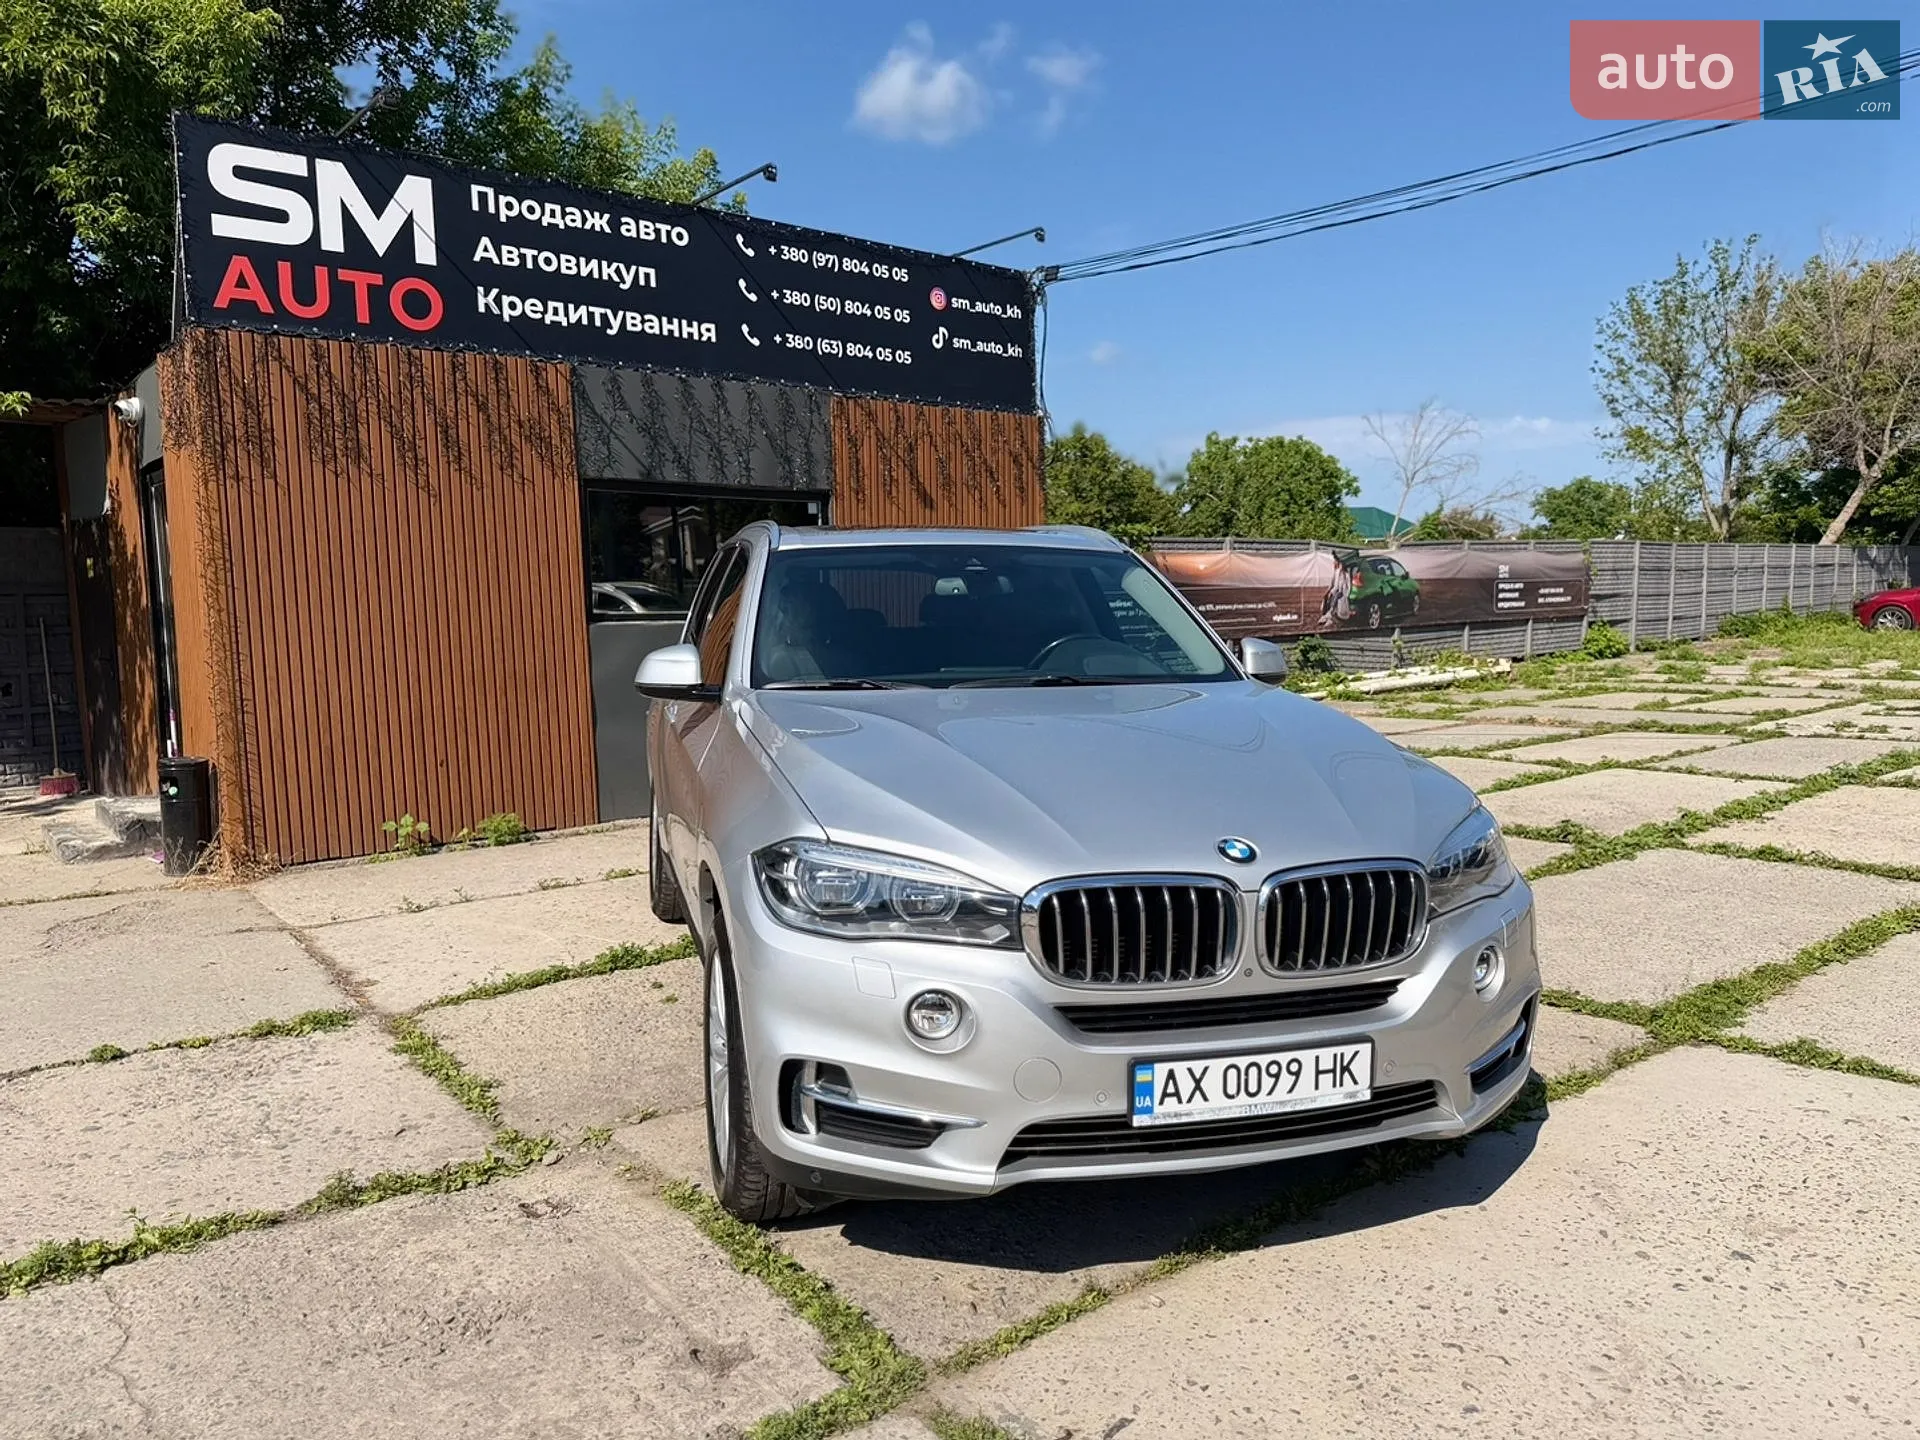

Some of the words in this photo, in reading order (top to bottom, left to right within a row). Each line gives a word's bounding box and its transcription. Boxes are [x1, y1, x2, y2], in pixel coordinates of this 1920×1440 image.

[207, 142, 438, 266] SM
[470, 183, 612, 234] Продаж
[619, 216, 690, 247] авто
[472, 235, 657, 290] Автовикуп
[768, 245, 778, 256] +
[780, 245, 809, 264] 380
[811, 250, 839, 272] (97)
[842, 257, 870, 276] 804
[872, 263, 890, 279] 05
[891, 267, 909, 283] 05
[213, 255, 445, 331] AUTO
[476, 286, 717, 343] Кредитування
[770, 289, 780, 300] +
[782, 289, 811, 307] 380
[814, 294, 842, 315] (50)
[844, 300, 872, 317] 804
[874, 305, 892, 321] 05
[893, 309, 911, 324] 05
[951, 296, 1022, 319] sm_auto_kh
[773, 333, 783, 344] +
[785, 333, 814, 351] 380
[816, 337, 843, 358] (63)
[846, 342, 874, 360] 804
[875, 346, 894, 362] 05
[894, 350, 912, 365] 05
[952, 337, 1023, 358] sm_auto_kh
[1158, 1065, 1210, 1107] AX
[1222, 1057, 1303, 1101] 0099
[1314, 1049, 1361, 1092] HK
[1135, 1096, 1152, 1108] UA
